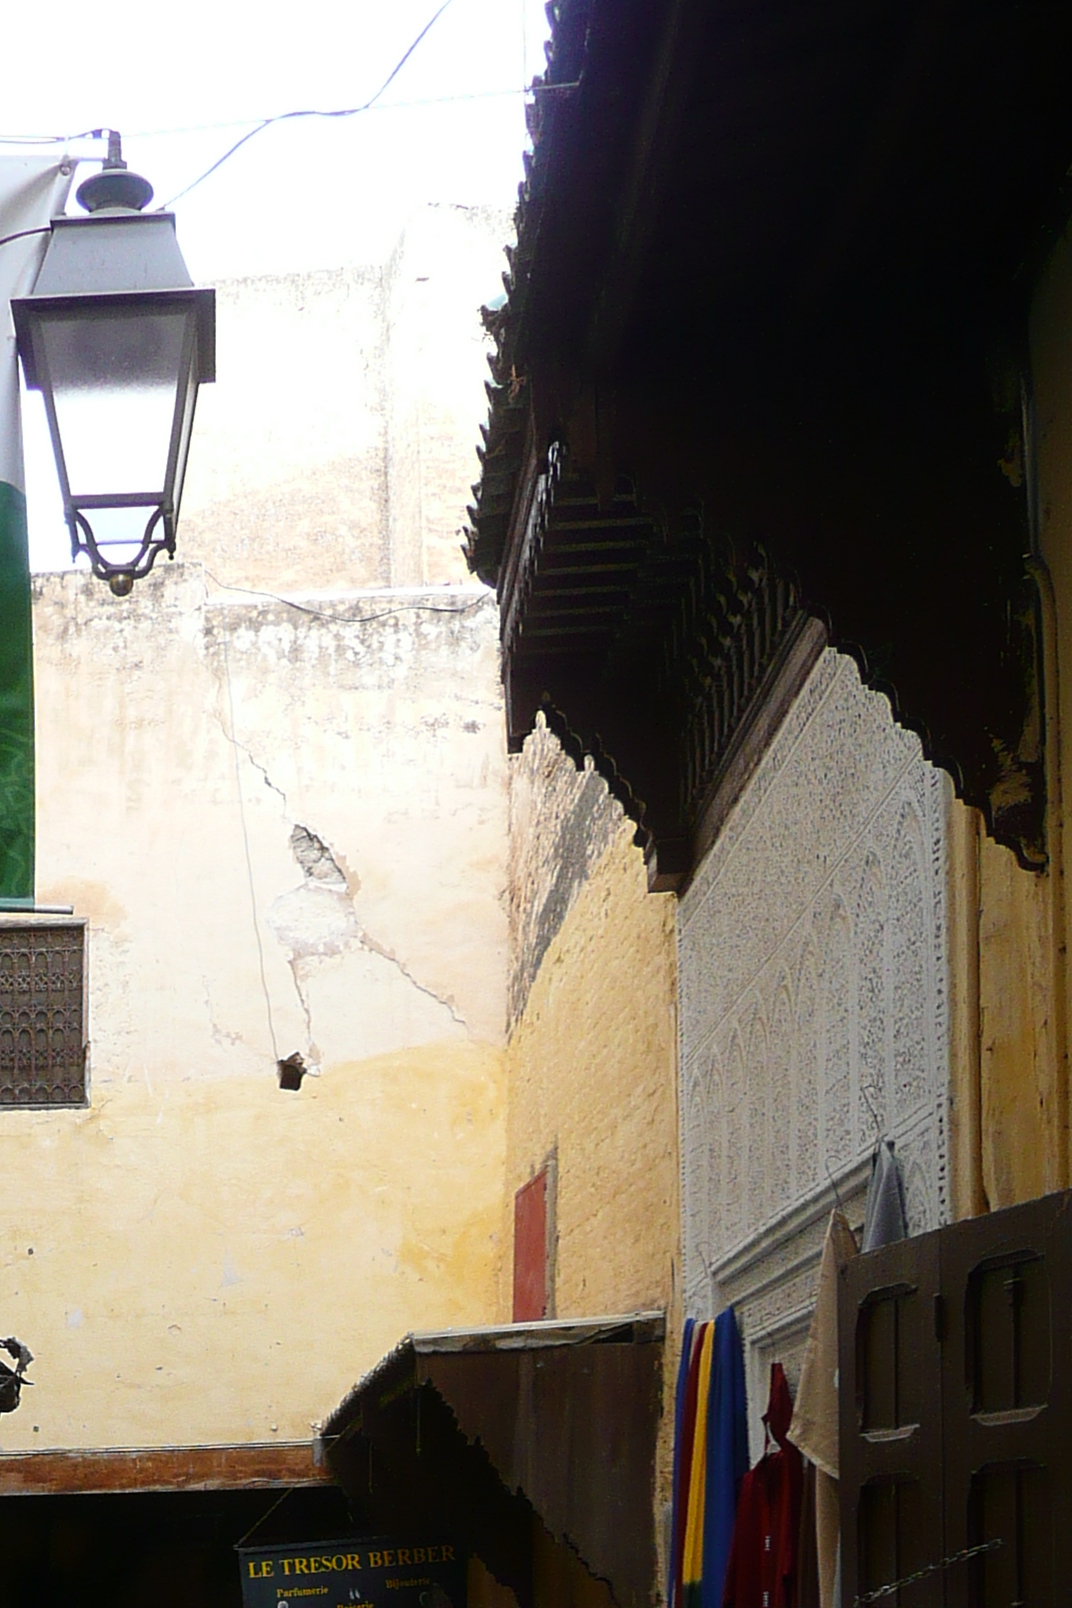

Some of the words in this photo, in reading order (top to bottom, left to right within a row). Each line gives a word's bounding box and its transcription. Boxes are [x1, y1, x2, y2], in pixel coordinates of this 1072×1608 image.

[248, 1560, 275, 1579] LE
[278, 1553, 363, 1576] TRESOR
[368, 1544, 456, 1568] BERBER
[276, 1585, 329, 1598] Parfumerie
